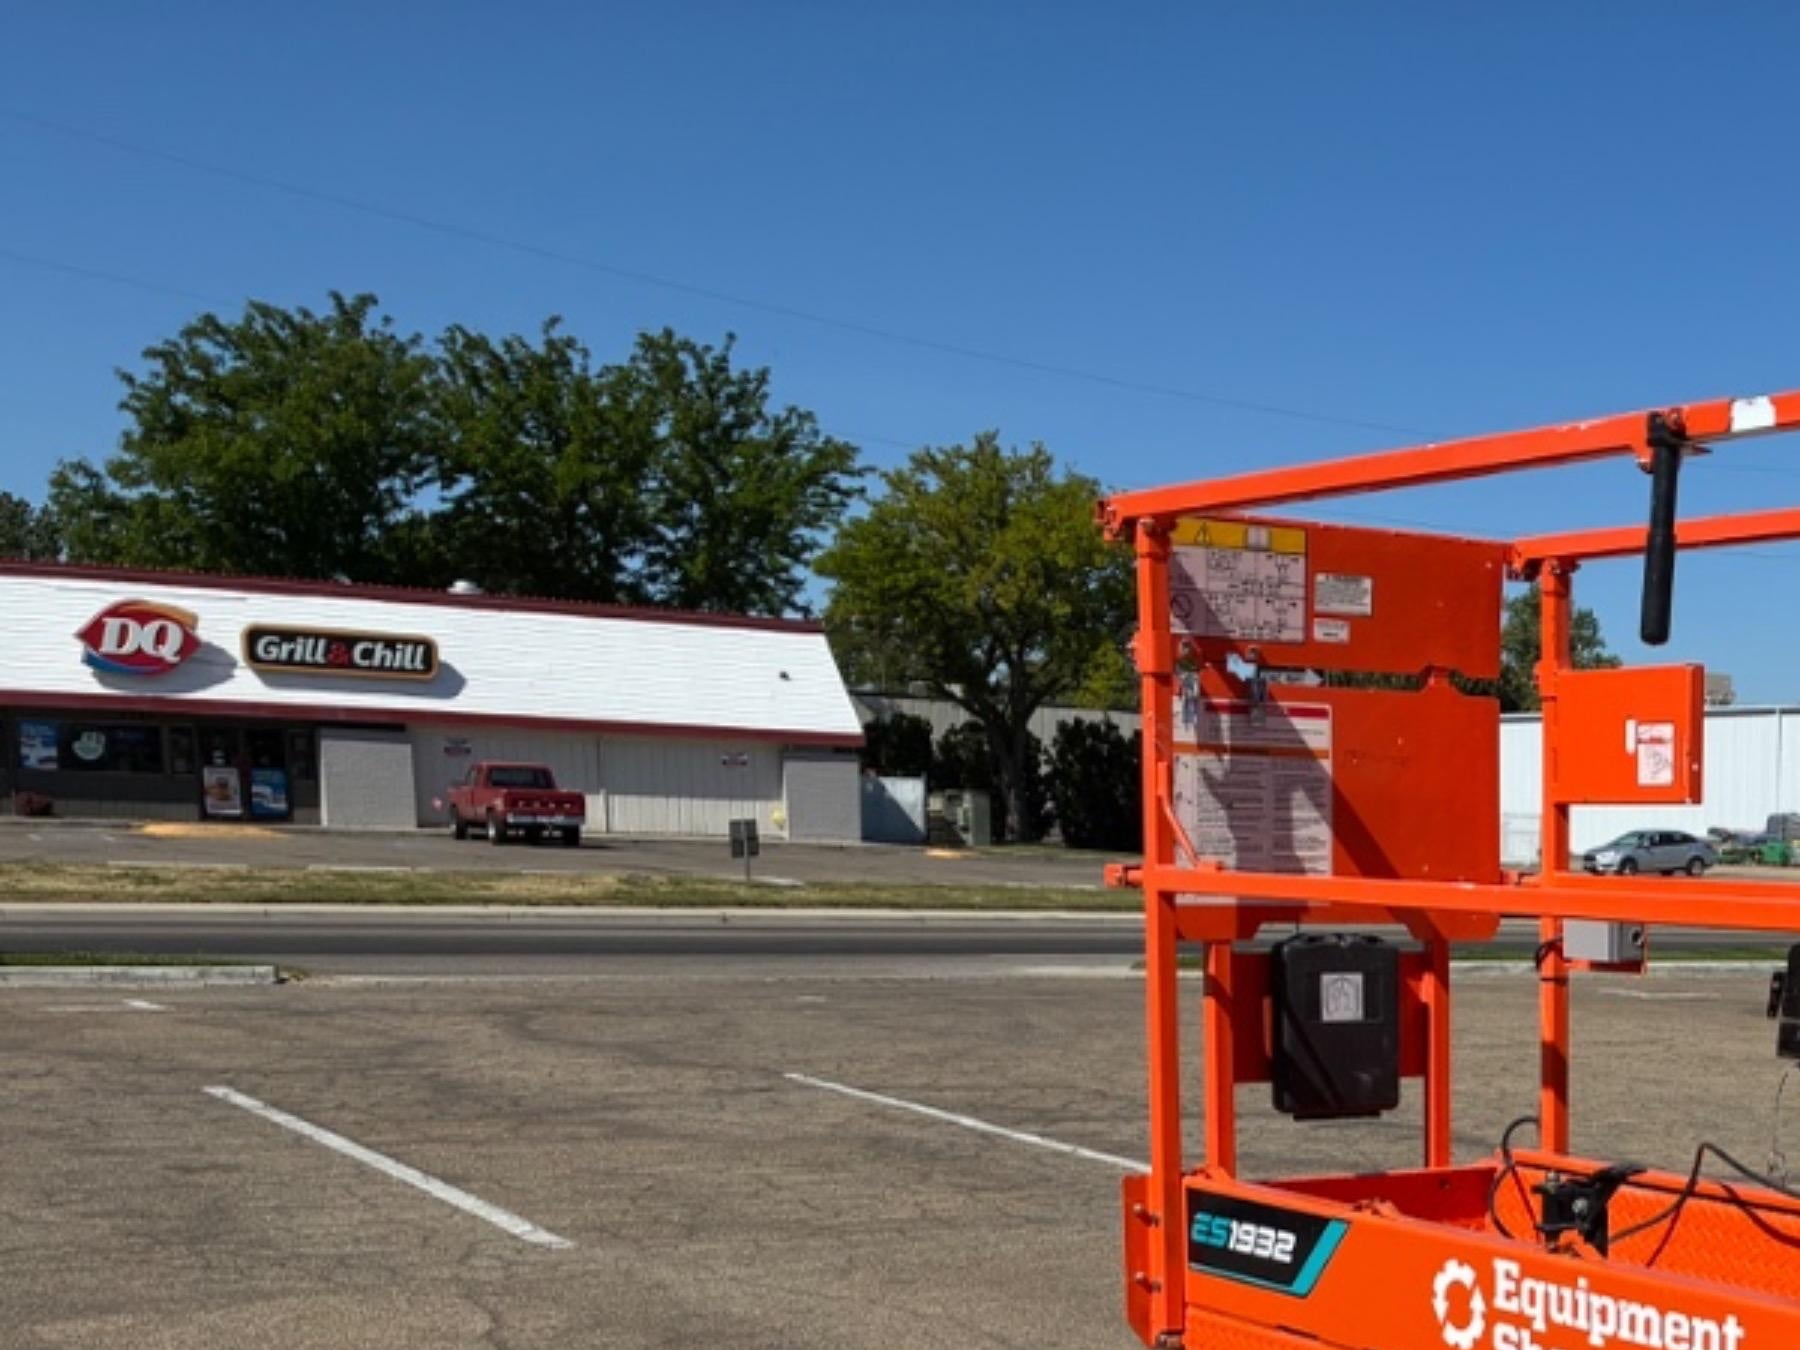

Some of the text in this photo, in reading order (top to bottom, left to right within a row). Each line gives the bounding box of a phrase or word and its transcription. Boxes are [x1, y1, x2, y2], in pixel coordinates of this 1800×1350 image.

[100, 617, 185, 662] DQ
[256, 635, 327, 664] Grill
[352, 641, 427, 671] Chill
[1191, 1212, 1297, 1264] ES1932
